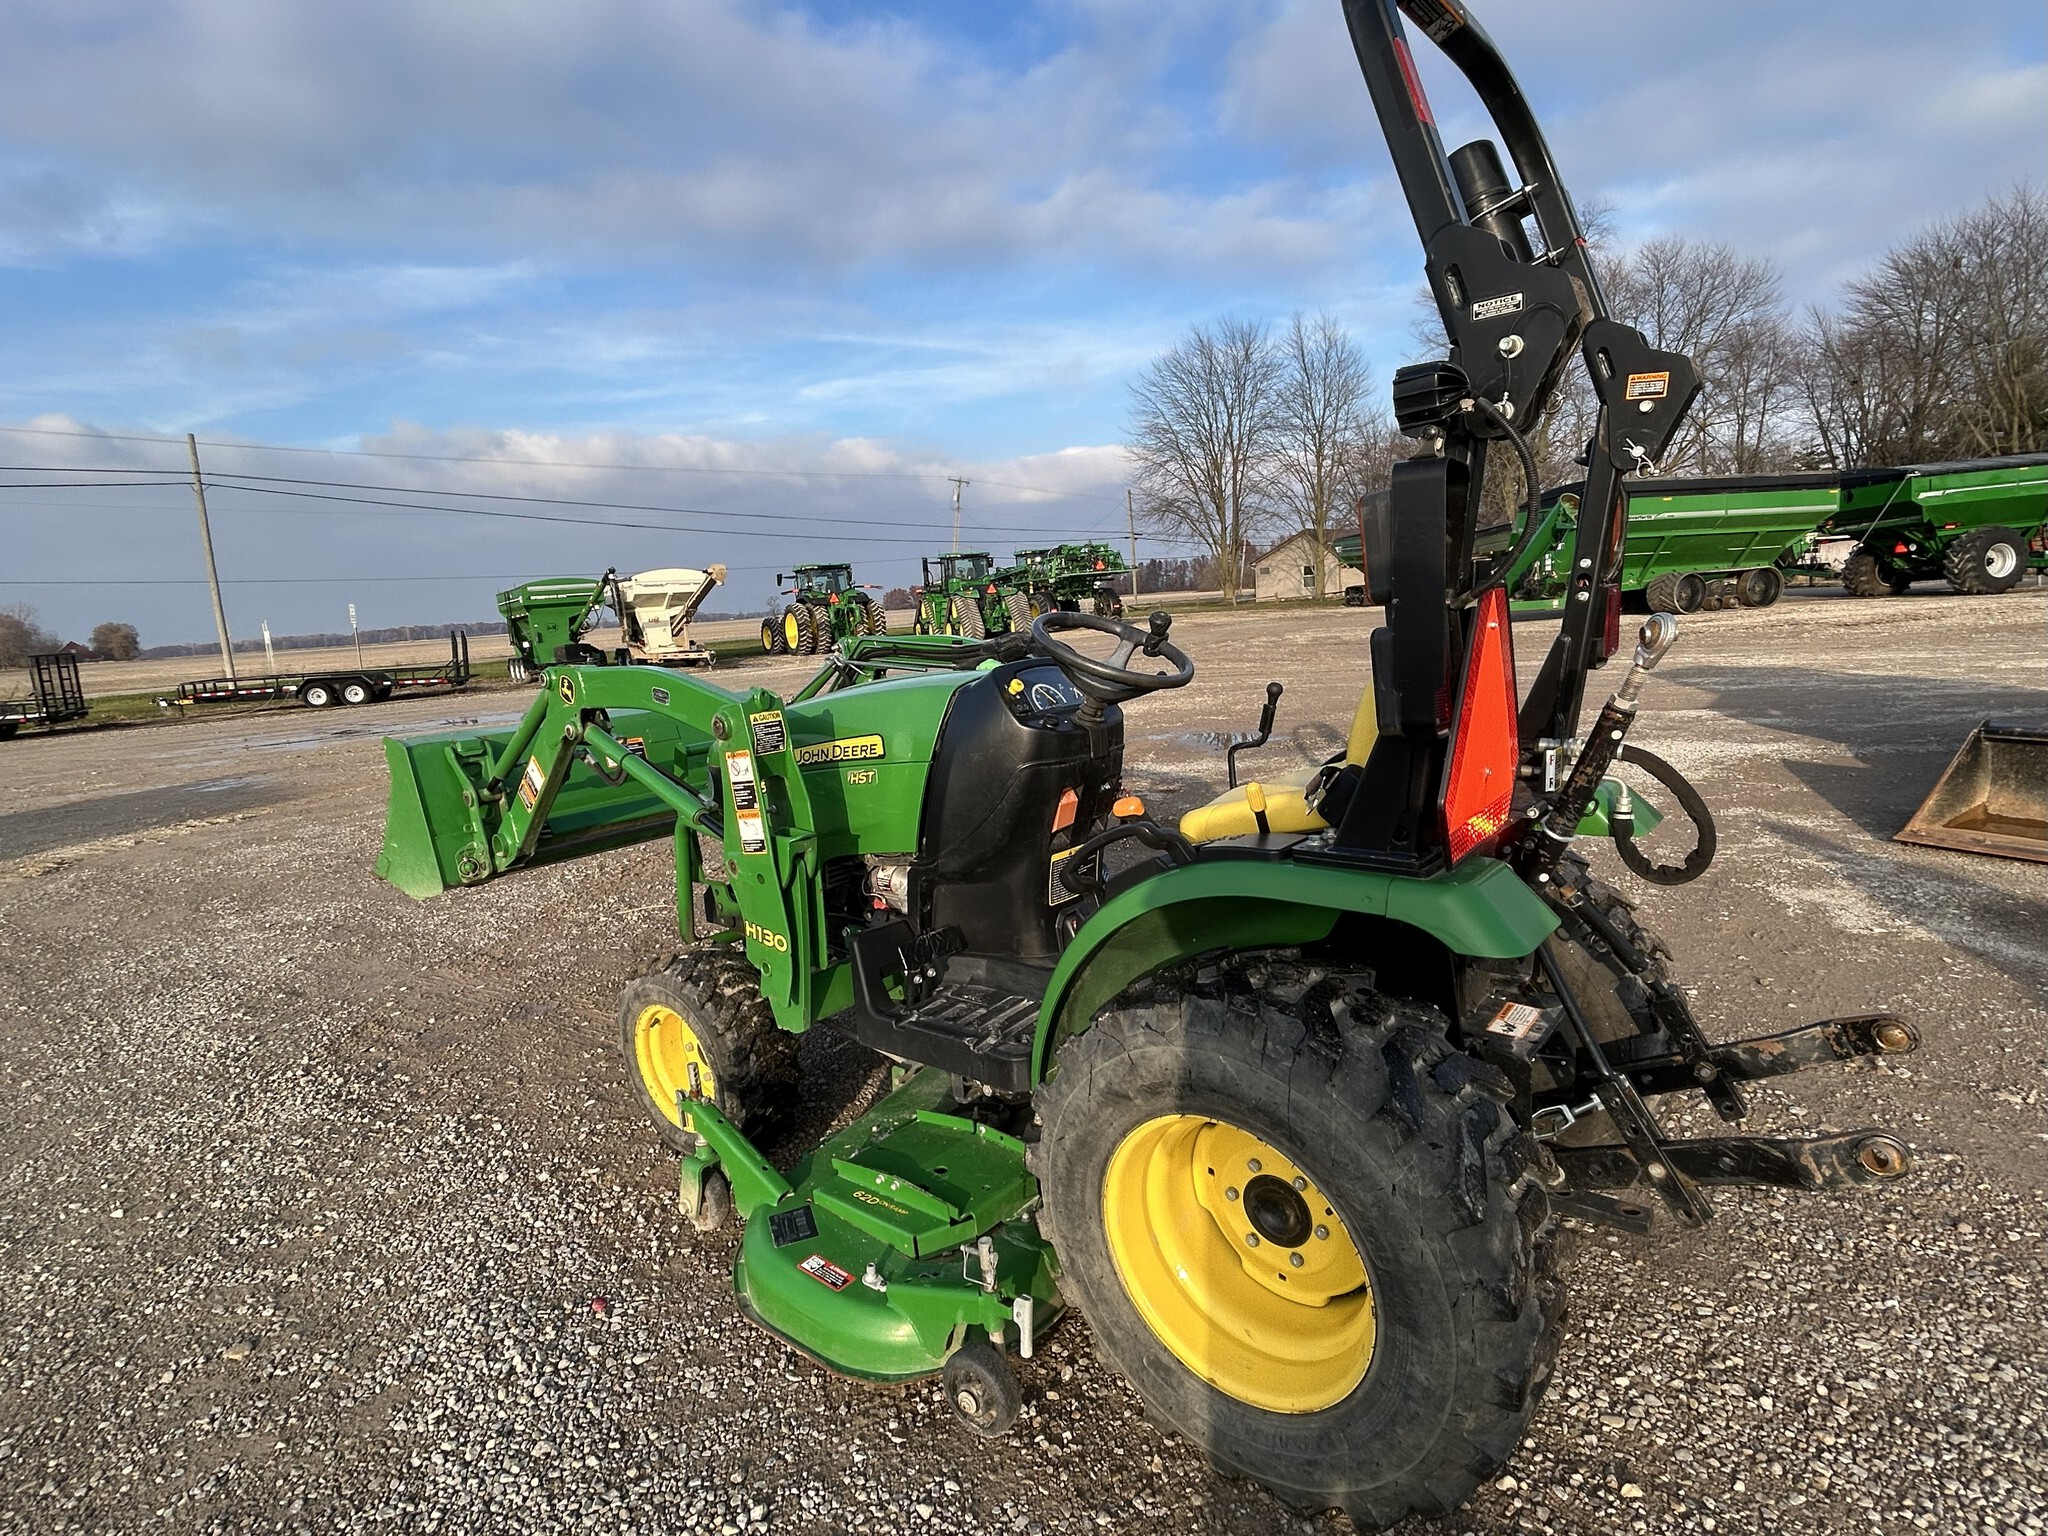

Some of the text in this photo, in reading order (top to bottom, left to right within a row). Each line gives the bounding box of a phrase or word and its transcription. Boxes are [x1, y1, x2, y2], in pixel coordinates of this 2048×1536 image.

[1477, 295, 1518, 309] NOTICE
[758, 712, 781, 721] CAUTION
[796, 743, 878, 764] JOHN DEERE
[848, 771, 876, 785] HST
[744, 920, 788, 953] H130
[852, 1190, 880, 1205] 62D
